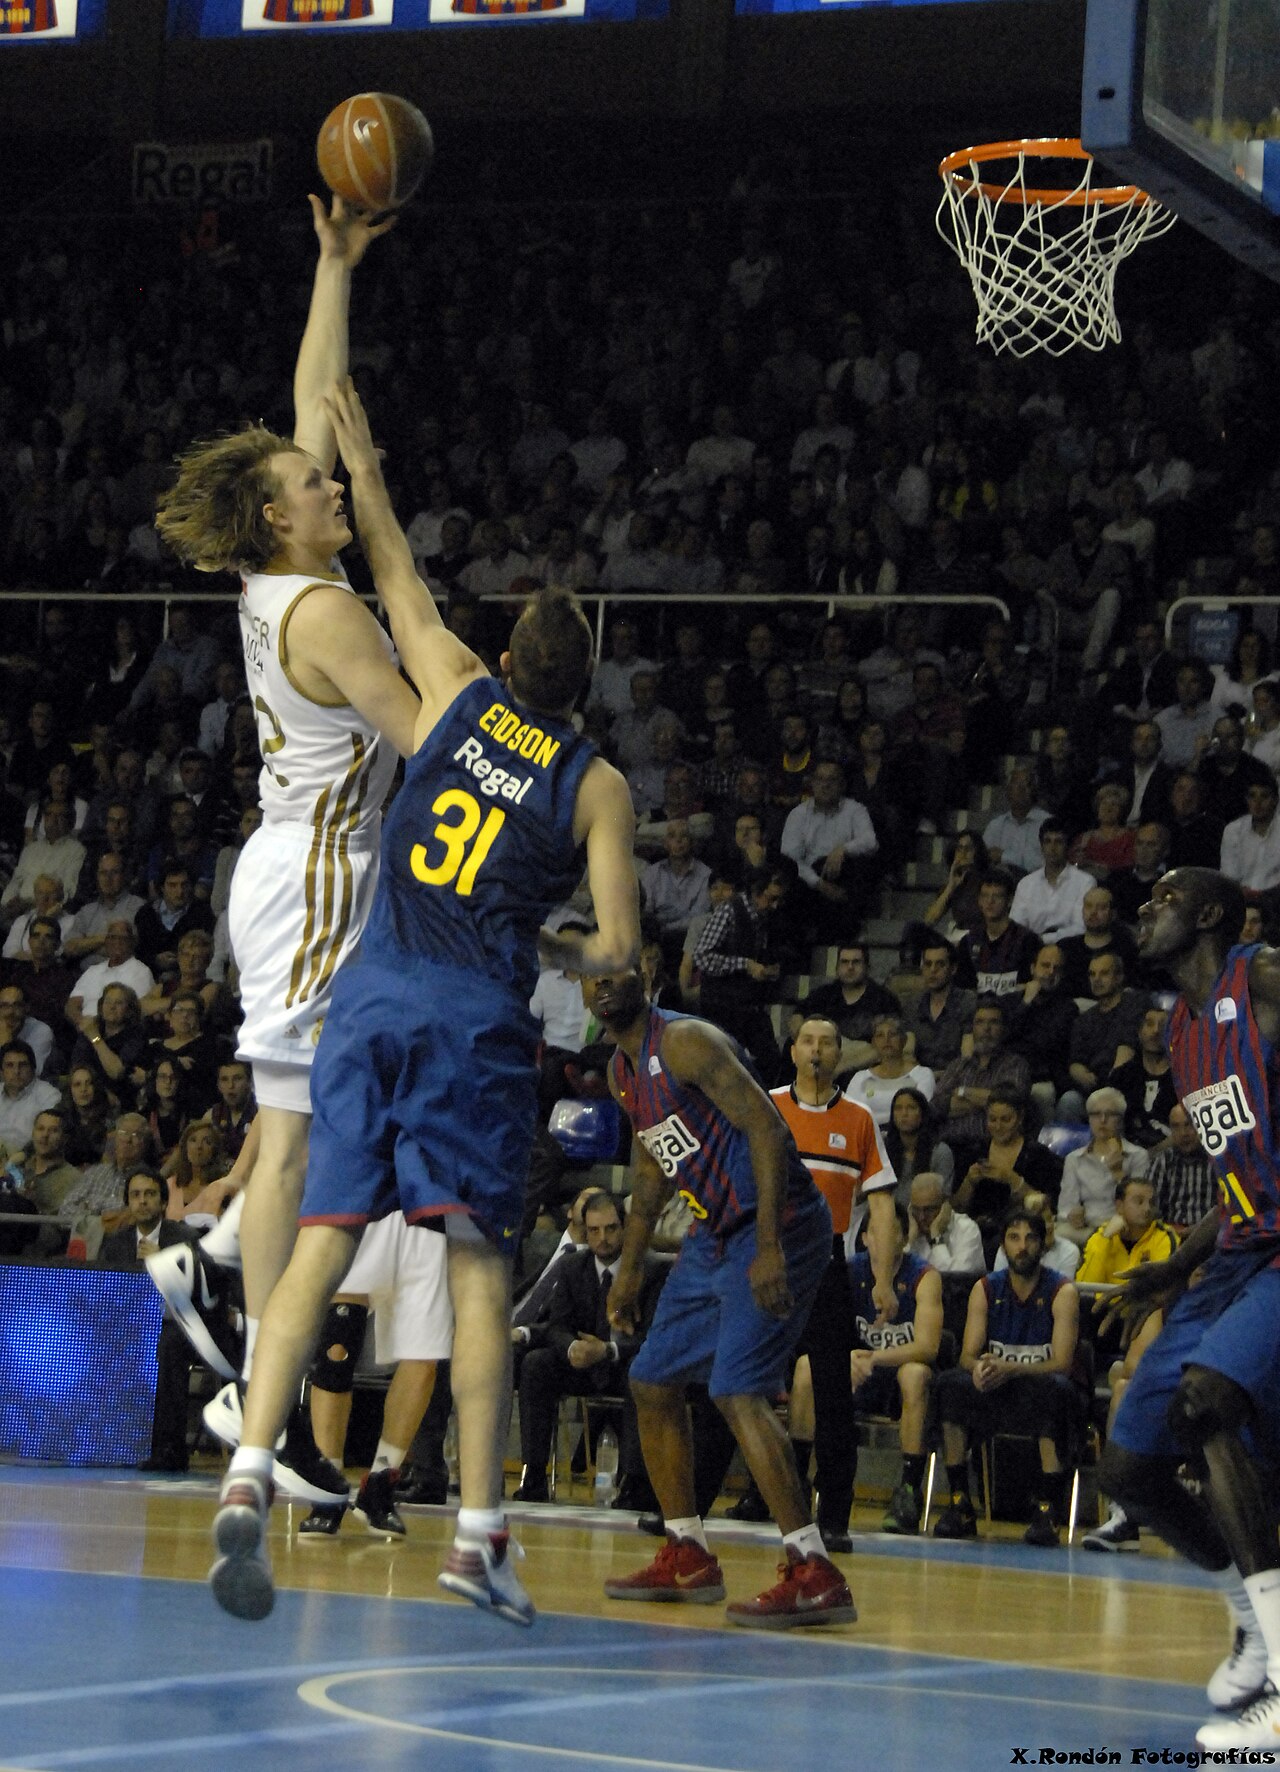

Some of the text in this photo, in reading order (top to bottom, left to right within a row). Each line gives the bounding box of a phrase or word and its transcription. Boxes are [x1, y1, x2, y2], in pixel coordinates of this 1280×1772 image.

[137, 144, 269, 209] Regal
[479, 703, 561, 769] EIDSON
[453, 736, 534, 805] Regal
[410, 788, 506, 896] 31
[985, 975, 1017, 992] Rega
[857, 1318, 914, 1349] Regal
